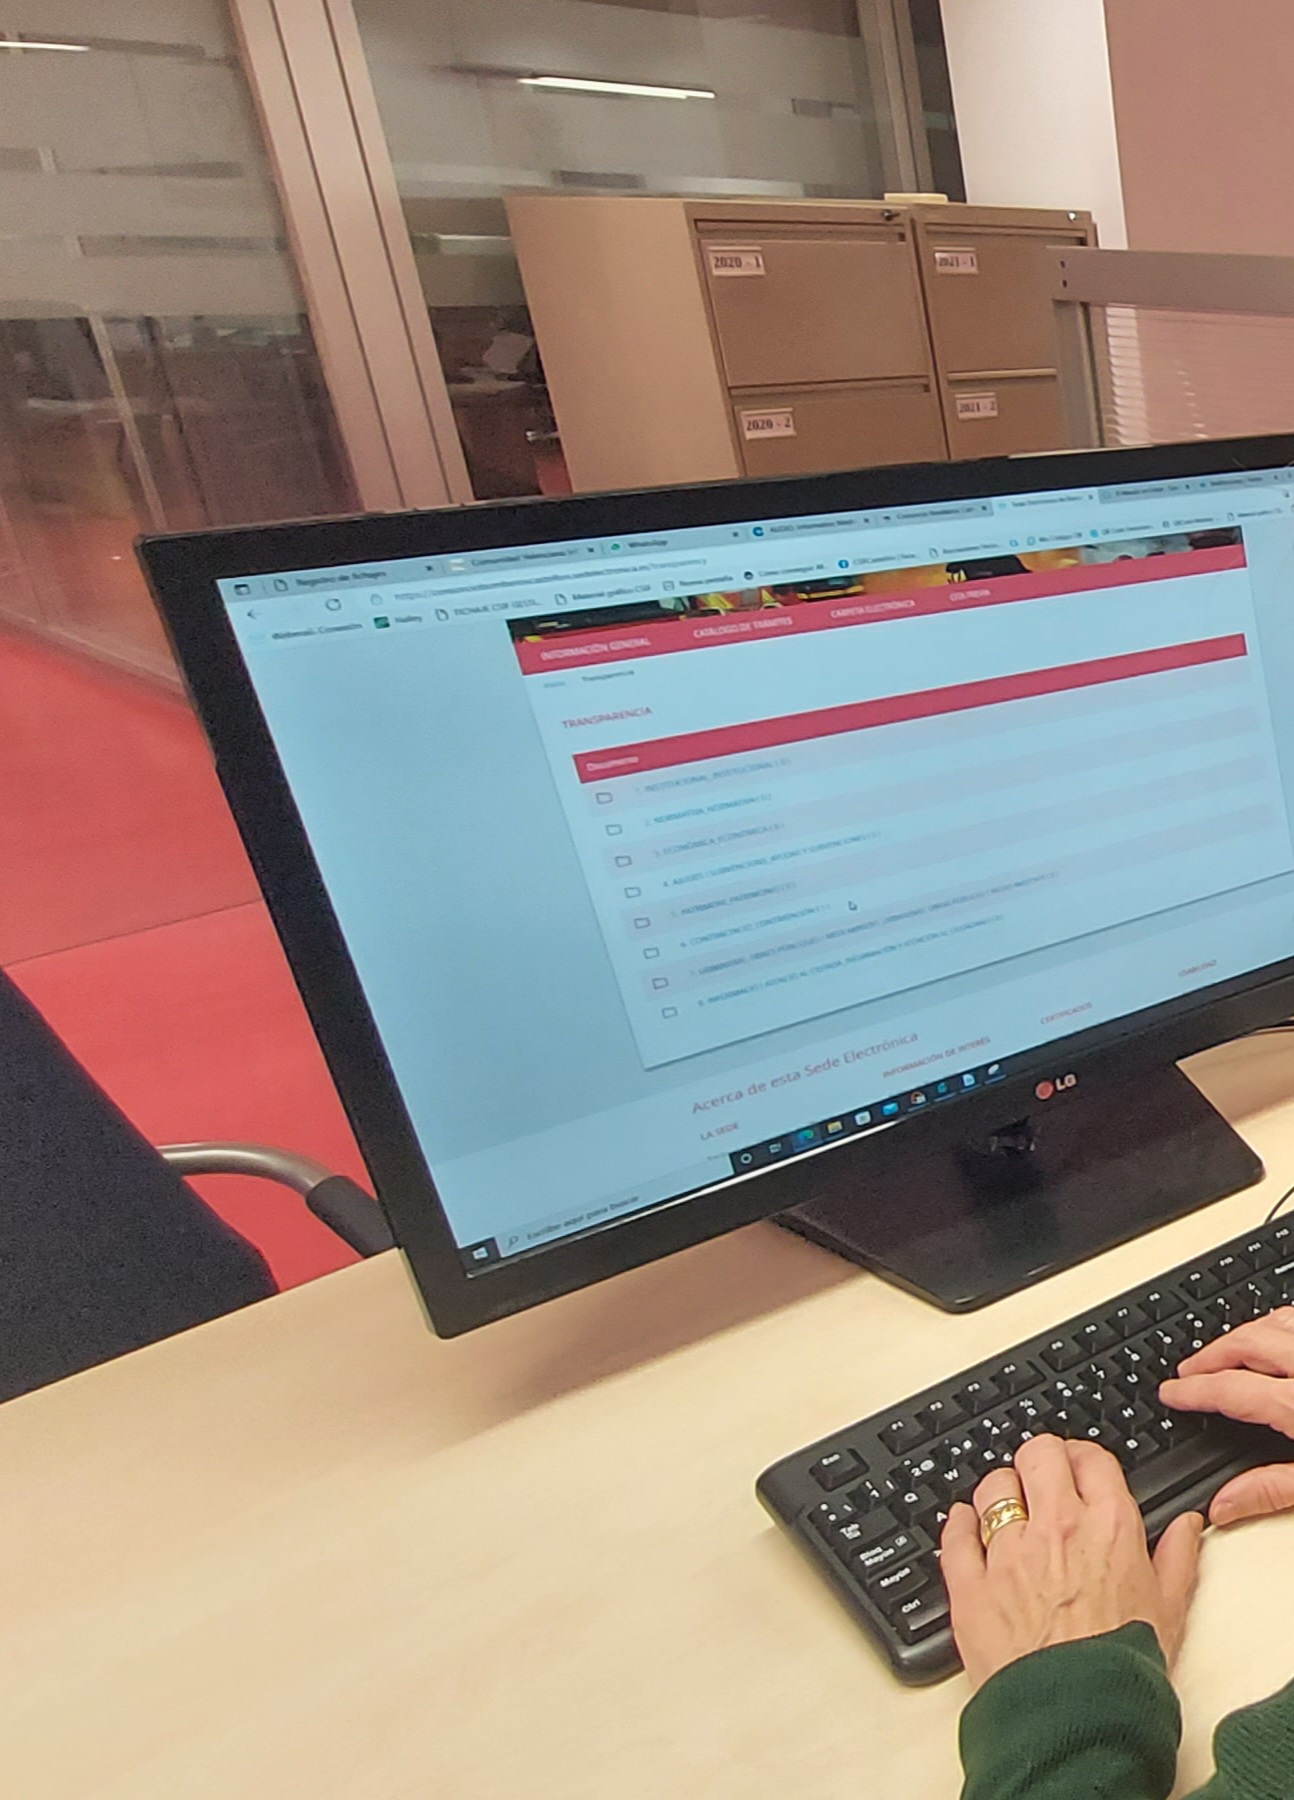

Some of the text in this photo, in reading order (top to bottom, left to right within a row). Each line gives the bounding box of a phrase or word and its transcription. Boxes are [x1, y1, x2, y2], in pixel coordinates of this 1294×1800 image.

[713, 256, 742, 268] 2020
[754, 256, 761, 268] 1
[970, 256, 975, 267] 1
[990, 401, 996, 412] 2
[746, 419, 774, 431] 2020
[784, 416, 791, 428] 2
[540, 637, 653, 661] INFORMACIÓN GENERAL
[561, 705, 653, 729] TRANSPARENCIA
[882, 1050, 944, 1078] INFORMACIÓN
[692, 1031, 918, 1114] Acerca de esta Sede Electrónica
[1055, 1072, 1078, 1092] LG
[700, 1121, 740, 1141] LA SEDE
[527, 1222, 562, 1241] Escribe
[586, 1206, 609, 1221] para
[610, 1195, 640, 1212] buscar
[1192, 1340, 1203, 1349] O
[1127, 1373, 1138, 1384] U
[1092, 1392, 1103, 1402] Y
[1057, 1411, 1067, 1421] T
[1122, 1407, 1135, 1419] H
[1161, 1419, 1173, 1431] N
[983, 1450, 995, 1461] E
[911, 1467, 922, 1478] 2
[943, 1468, 960, 1482] W
[905, 1492, 918, 1504] Q
[937, 1512, 948, 1523] A
[901, 1598, 922, 1614] Ctrl
